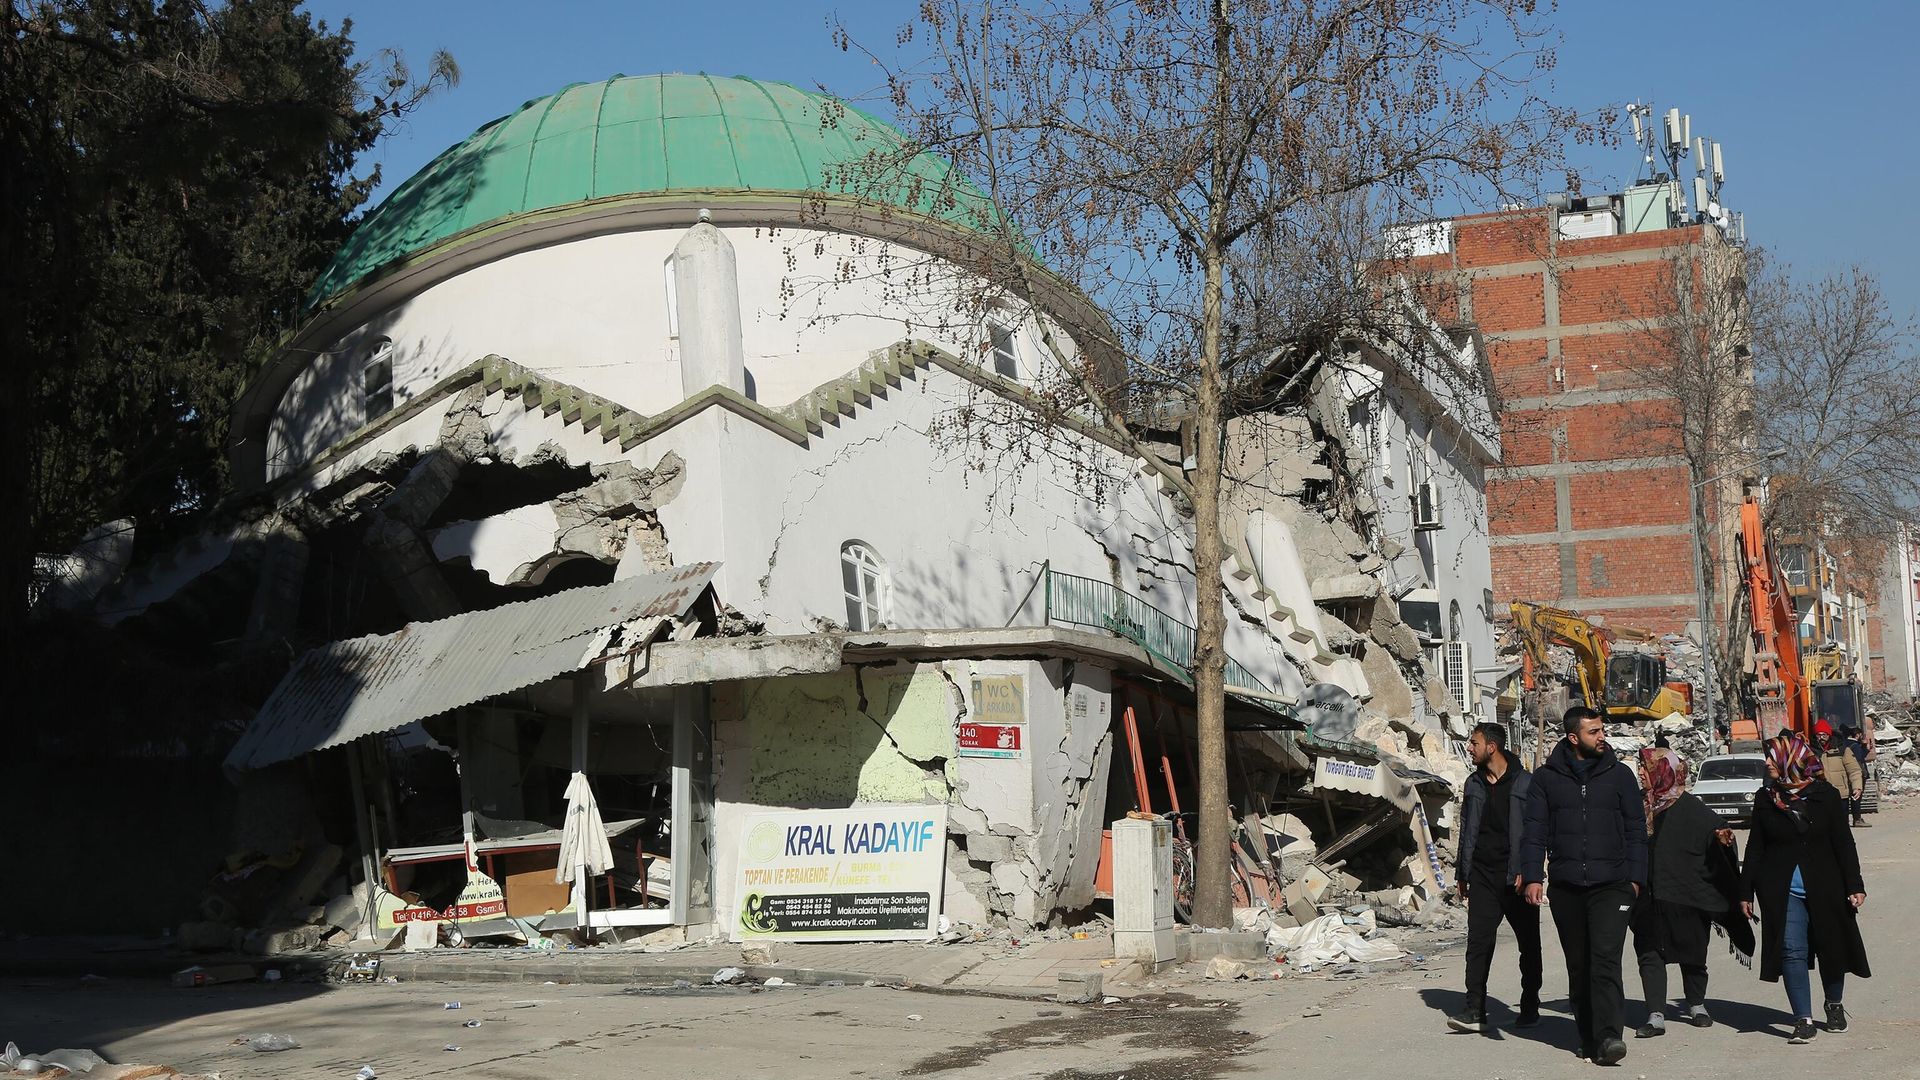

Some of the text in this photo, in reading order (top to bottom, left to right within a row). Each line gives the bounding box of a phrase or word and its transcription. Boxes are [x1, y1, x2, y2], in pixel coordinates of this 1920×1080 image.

[987, 685, 1009, 698] WC
[986, 701, 1016, 713] ARKADA
[1315, 701, 1345, 713] arçelik
[785, 820, 934, 856] KRAL KADAYIF
[744, 867, 829, 885] TOPTAN VE PERAKENDE
[890, 896, 904, 904] Son
[905, 895, 928, 904] Sistem
[476, 904, 497, 914] Gsm:
[837, 906, 878, 915] Makinalarla
[791, 917, 877, 928] www.kralkadayif.com
